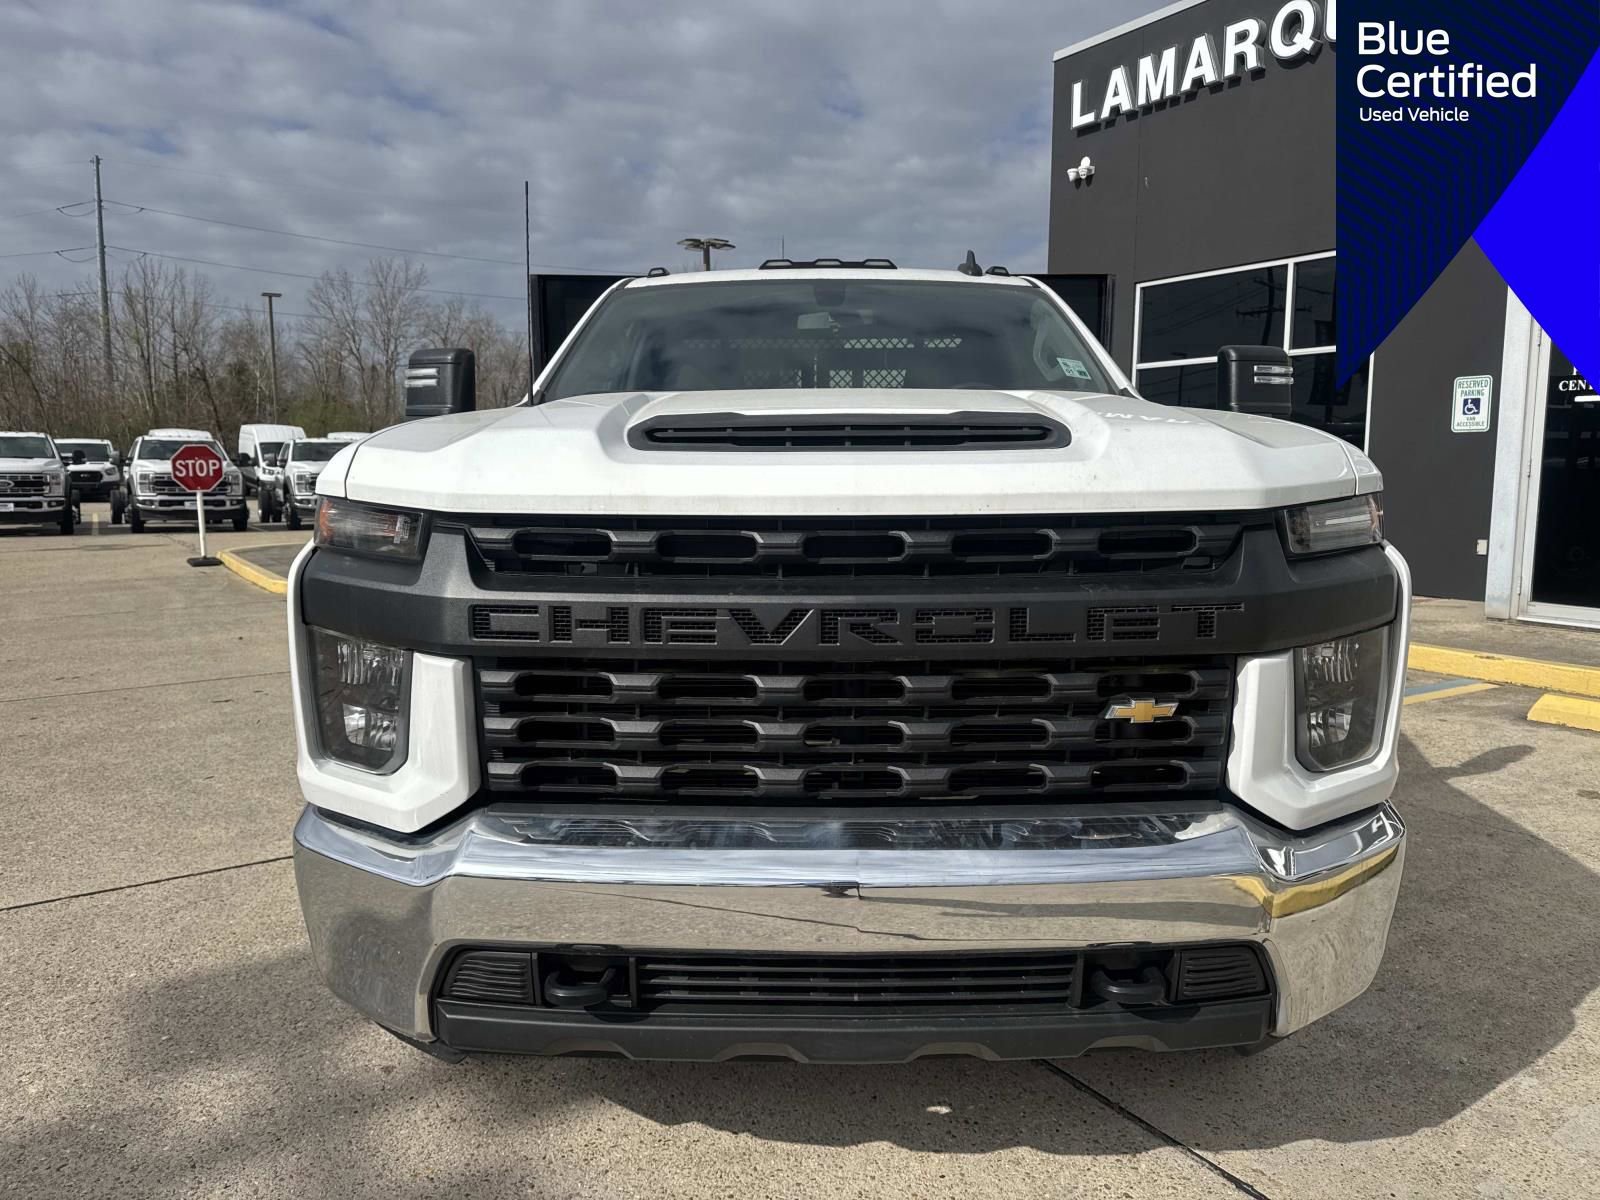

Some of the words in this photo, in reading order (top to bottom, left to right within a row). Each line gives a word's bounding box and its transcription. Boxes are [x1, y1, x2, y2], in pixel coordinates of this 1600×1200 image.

[1457, 379, 1489, 389] RESERVED
[1558, 379, 1594, 392] CEN
[1460, 388, 1485, 397] PARKING
[175, 460, 220, 477] STOP
[469, 602, 1246, 647] CHEVROLET
